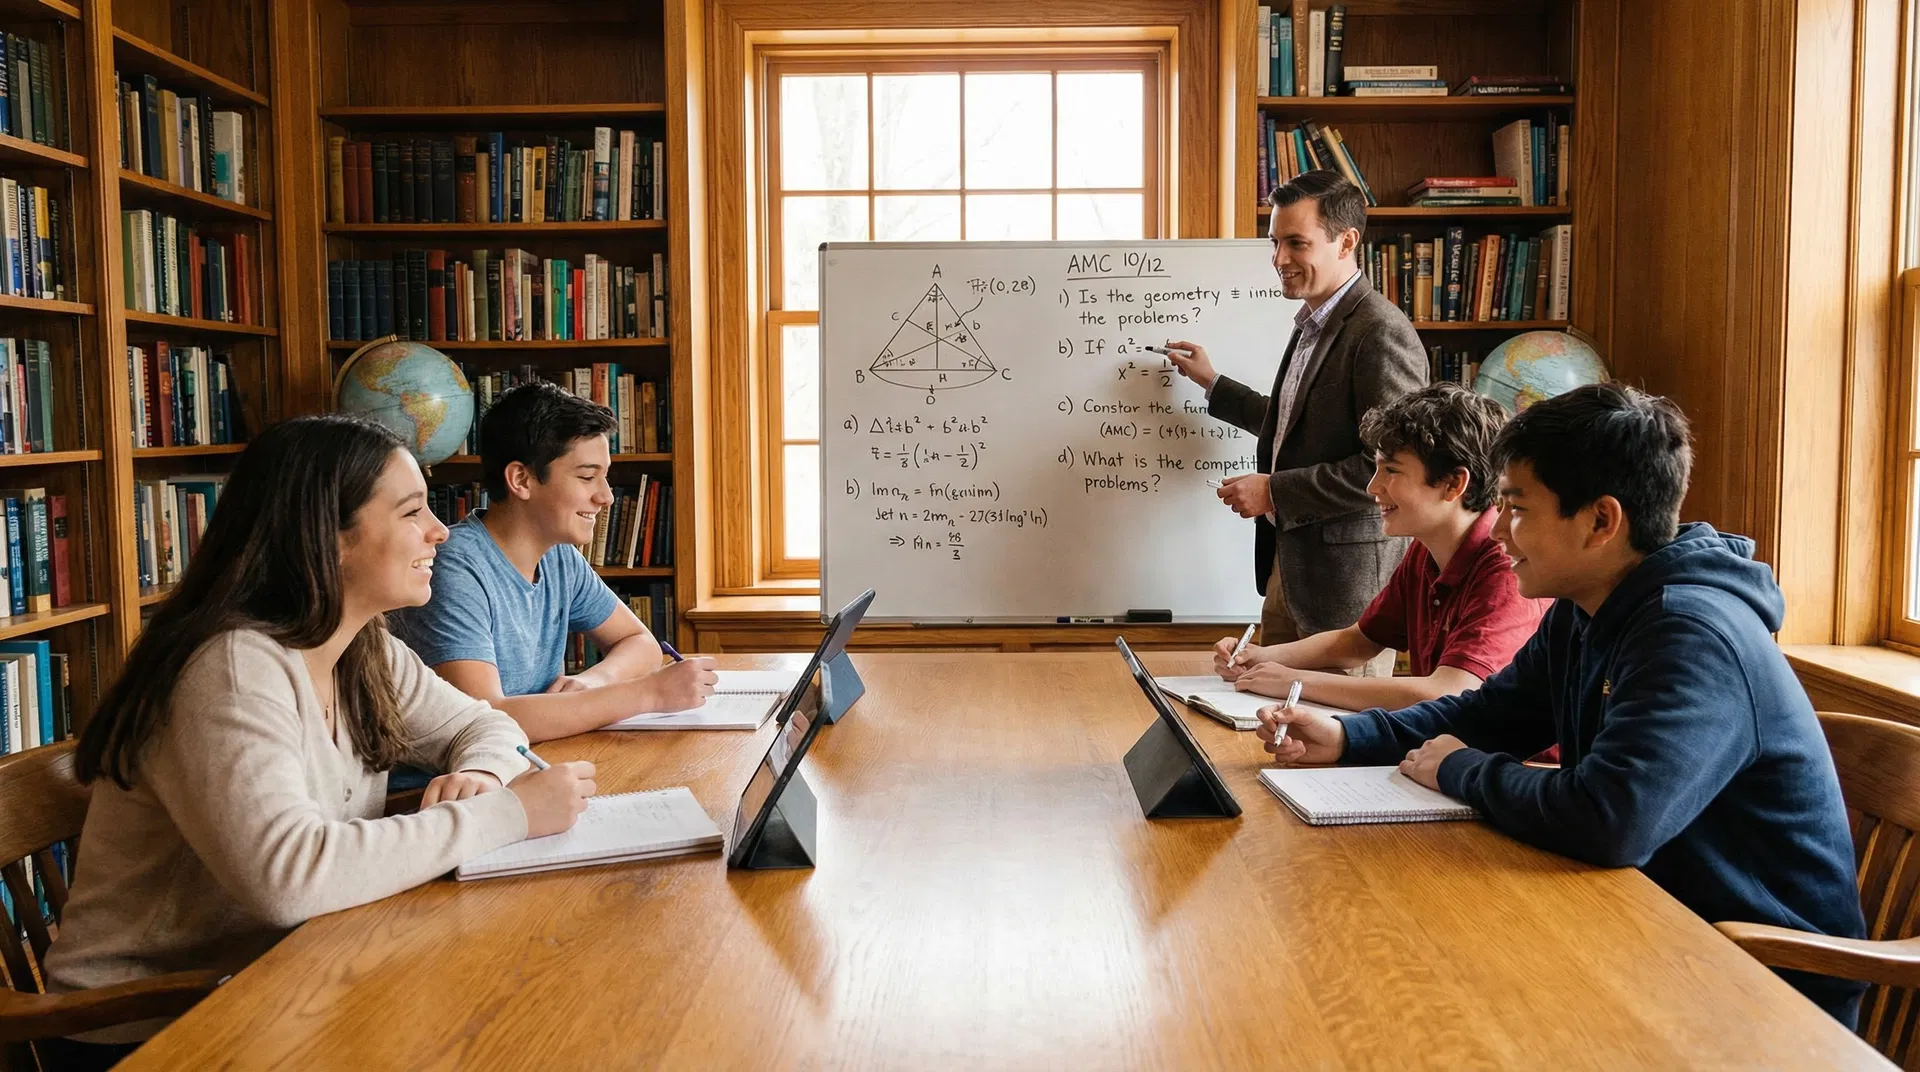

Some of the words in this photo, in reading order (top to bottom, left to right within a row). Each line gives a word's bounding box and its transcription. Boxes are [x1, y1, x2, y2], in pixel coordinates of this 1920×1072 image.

[931, 263, 942, 278] A
[1066, 253, 1113, 274] AMC
[1123, 252, 1165, 277] 10/12
[1078, 289, 1098, 304] Is
[1106, 288, 1135, 304] the
[1144, 286, 1221, 308] geometry
[1078, 311, 1107, 325] the
[1058, 338, 1074, 359] b)
[1084, 339, 1106, 356] If
[855, 369, 866, 384] B
[1001, 367, 1013, 381] C
[1057, 396, 1074, 416] c)
[1148, 400, 1174, 415] the
[843, 413, 859, 435] a)
[1099, 421, 1138, 440] (AMC)
[1057, 445, 1075, 470] d)
[1082, 450, 1125, 467] What
[1134, 454, 1148, 469] is
[1156, 453, 1185, 471] the
[846, 478, 861, 500] b)
[900, 511, 909, 521] n
